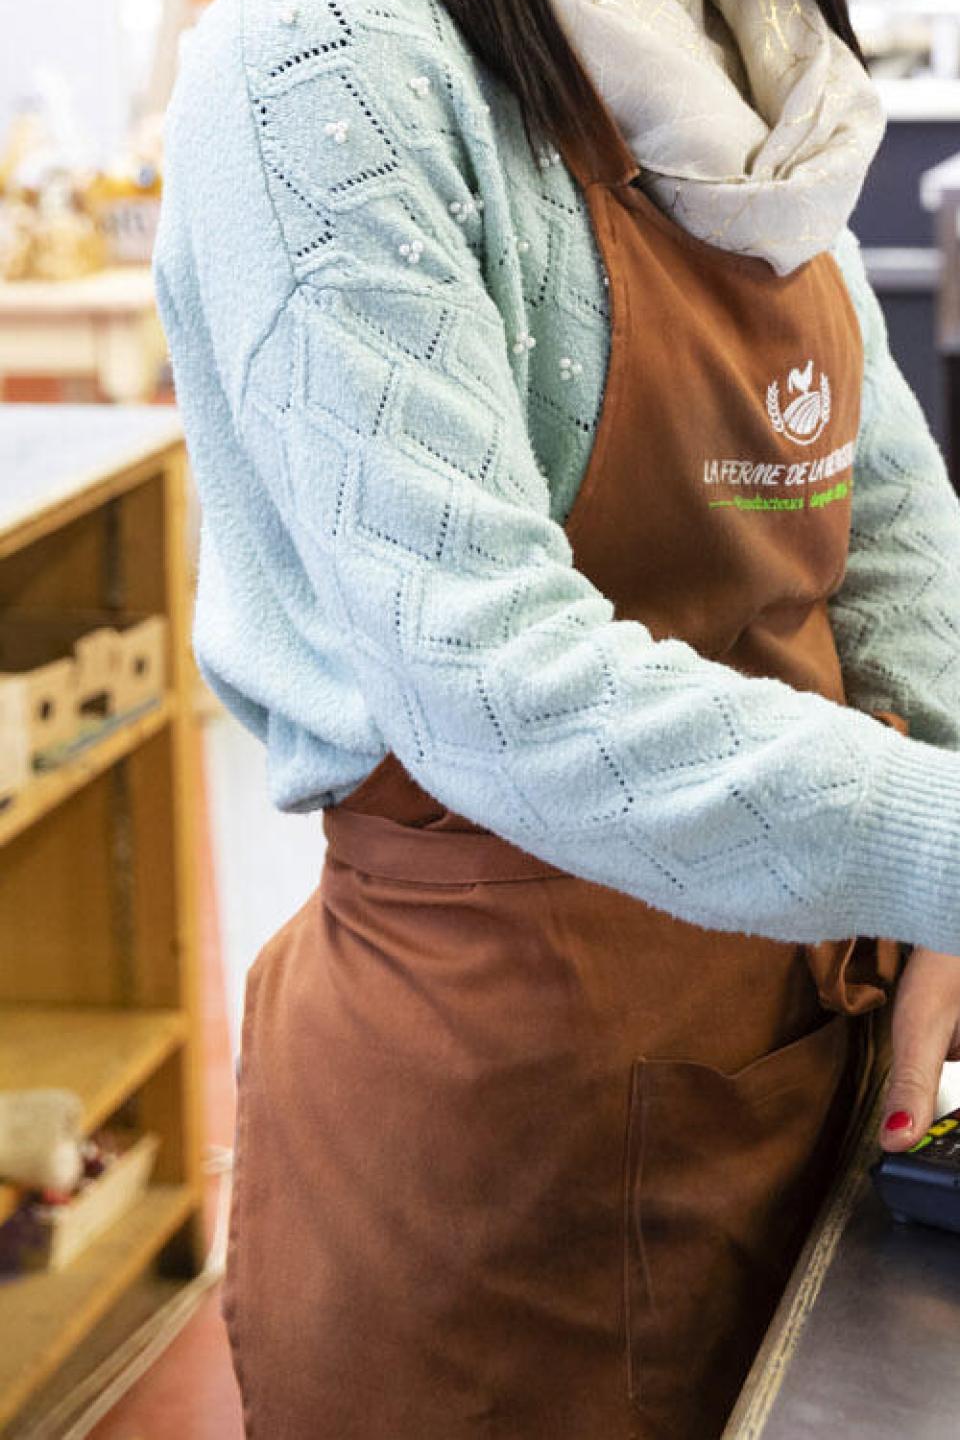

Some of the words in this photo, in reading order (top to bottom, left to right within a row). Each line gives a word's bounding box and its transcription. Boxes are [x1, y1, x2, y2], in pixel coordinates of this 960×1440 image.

[703, 459, 719, 484] LA
[720, 460, 785, 486] FERME
[785, 462, 811, 486] DE
